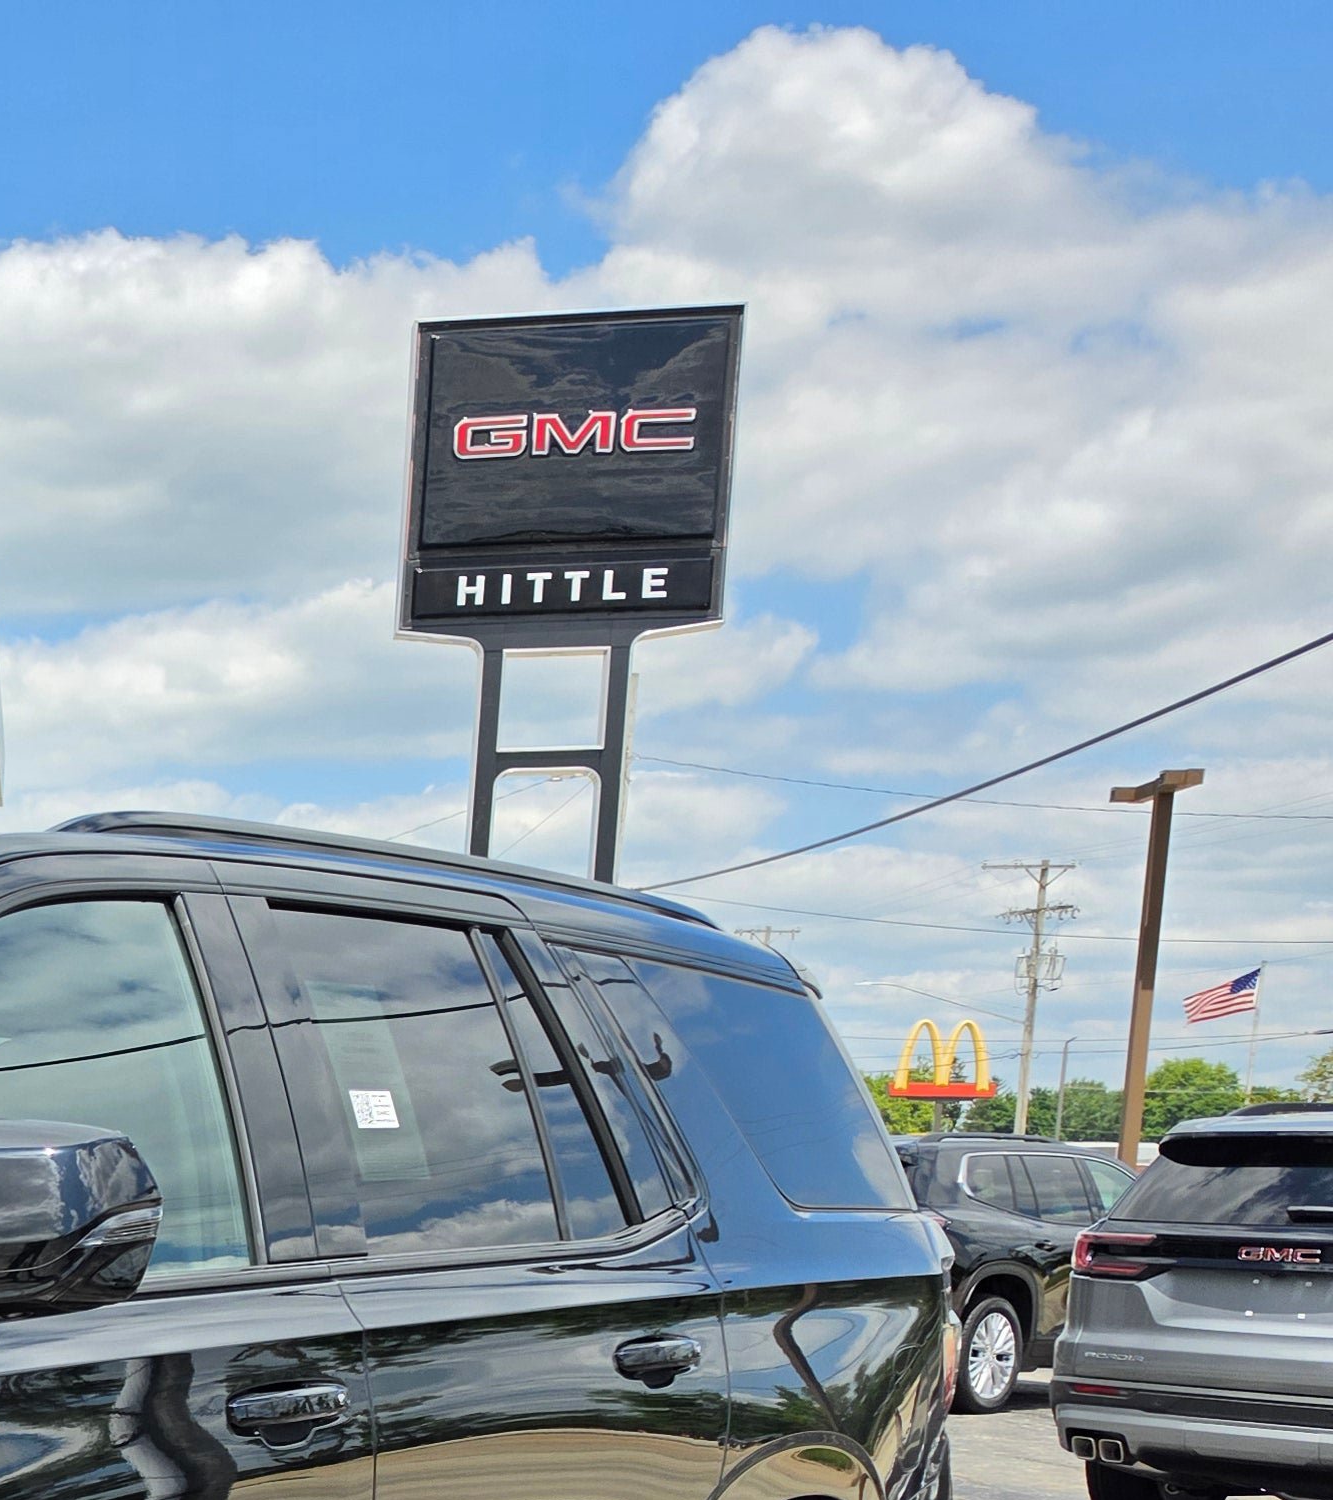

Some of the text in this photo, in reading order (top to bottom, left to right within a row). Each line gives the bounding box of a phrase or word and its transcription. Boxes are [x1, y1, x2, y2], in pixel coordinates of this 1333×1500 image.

[454, 407, 697, 460] GMC
[456, 567, 669, 606] HITTLE
[1237, 1246, 1322, 1263] GMC
